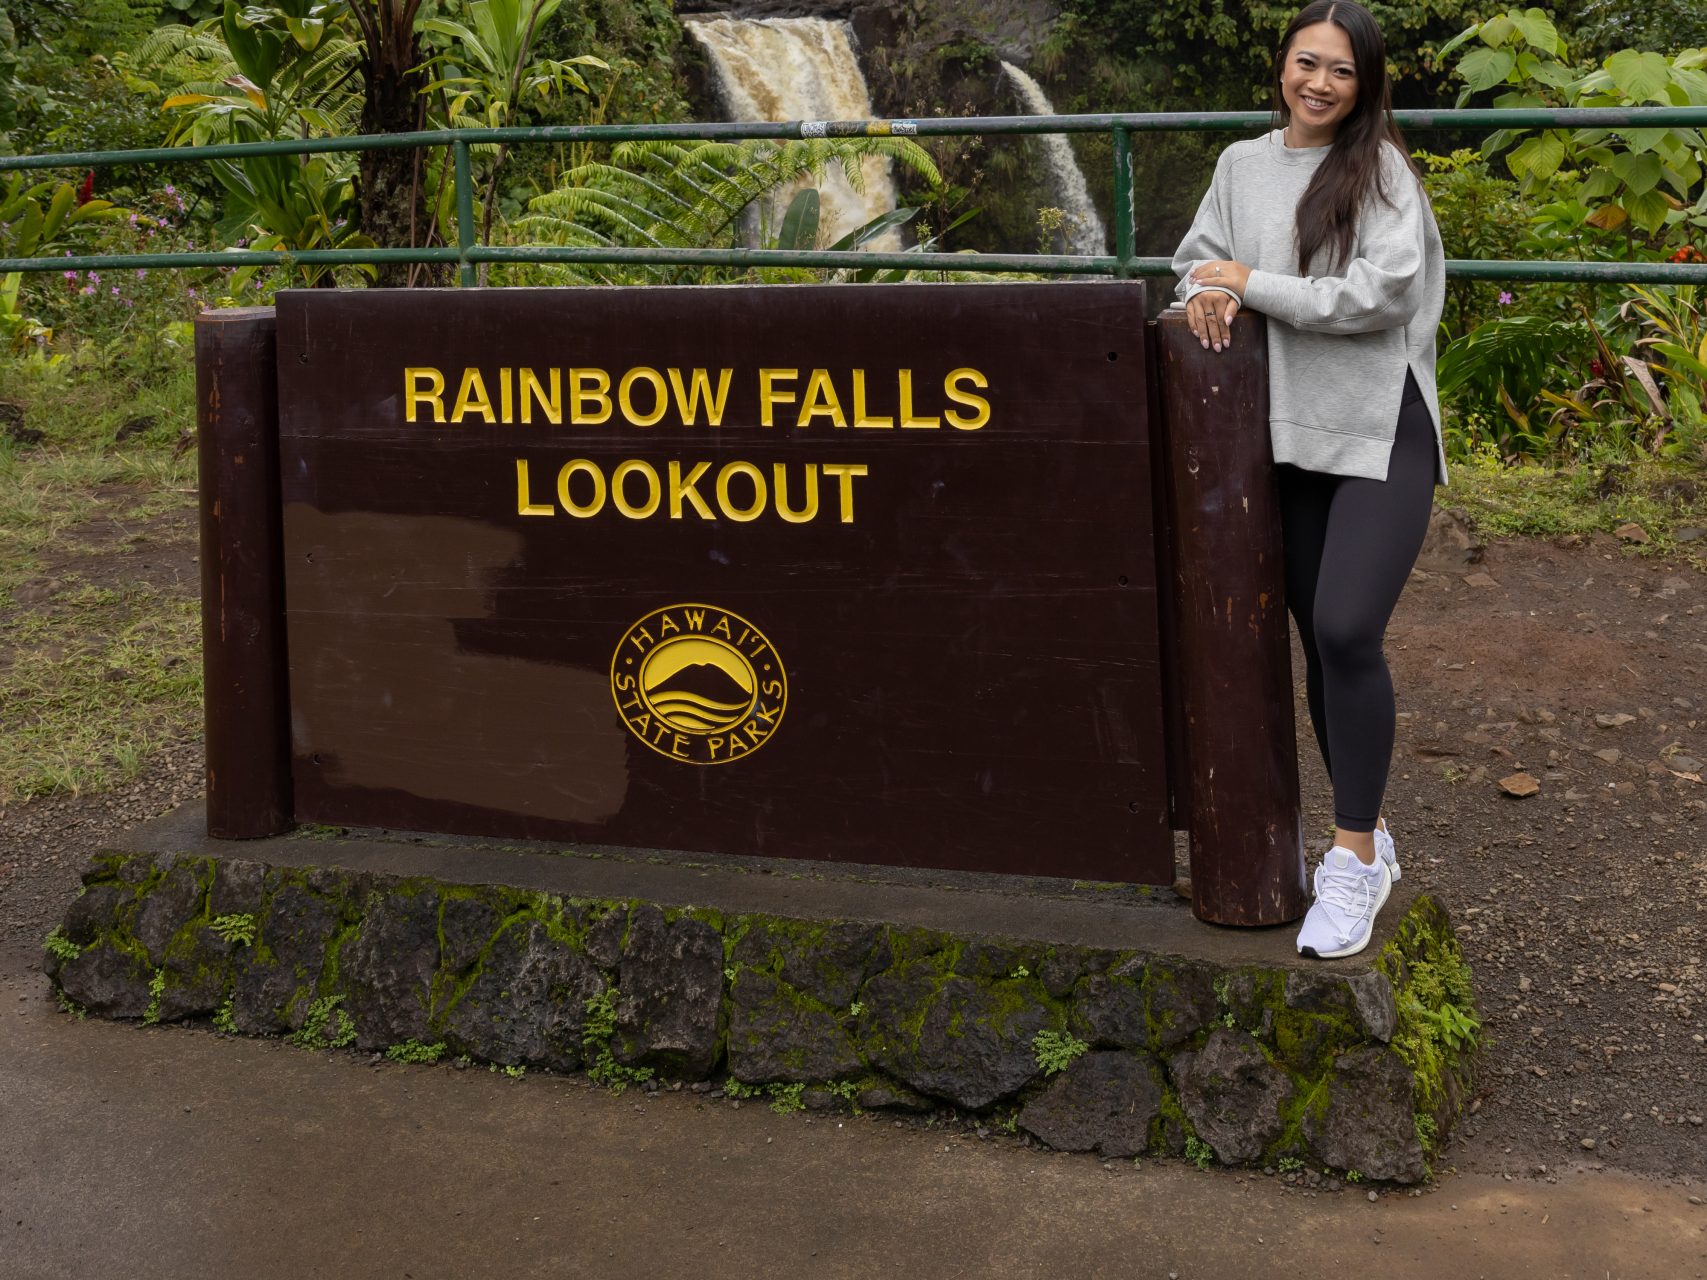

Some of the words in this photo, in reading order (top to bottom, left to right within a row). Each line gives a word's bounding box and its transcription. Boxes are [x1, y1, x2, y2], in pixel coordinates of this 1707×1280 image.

[404, 366, 733, 427] RAINBOW
[758, 368, 991, 431] FALLS
[516, 458, 869, 524] LOOKOUT
[615, 671, 691, 758] STATE
[706, 679, 783, 760] PARKS
